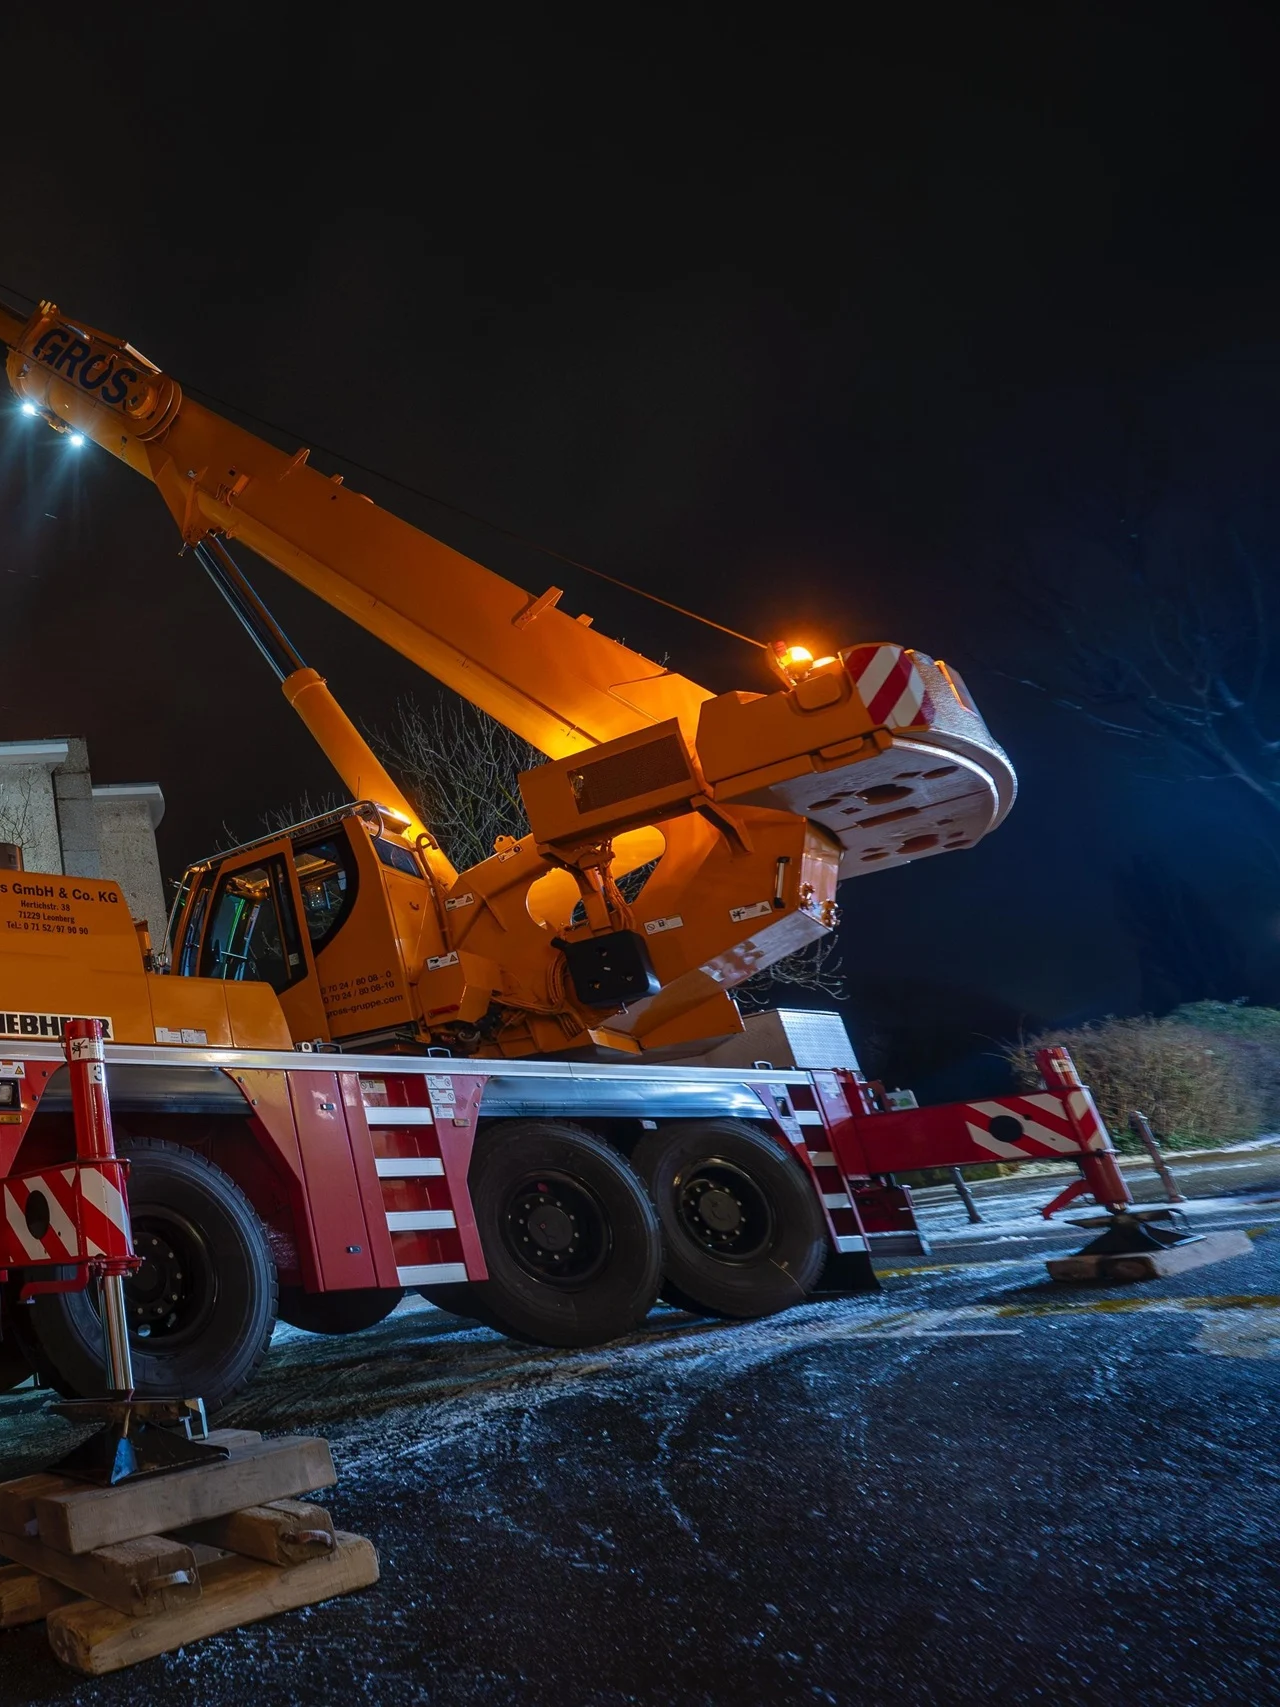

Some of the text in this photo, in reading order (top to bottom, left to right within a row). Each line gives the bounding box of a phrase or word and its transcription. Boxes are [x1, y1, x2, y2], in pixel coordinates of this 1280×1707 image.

[33, 328, 142, 412] GROS
[12, 883, 54, 897] GmbH
[59, 887, 68, 899] &
[72, 889, 94, 901] Co.
[98, 891, 119, 903] KG
[18, 910, 75, 924] 71229 Leonberg
[23, 922, 29, 930] 0
[31, 922, 39, 931] 71
[79, 927, 89, 935] 90
